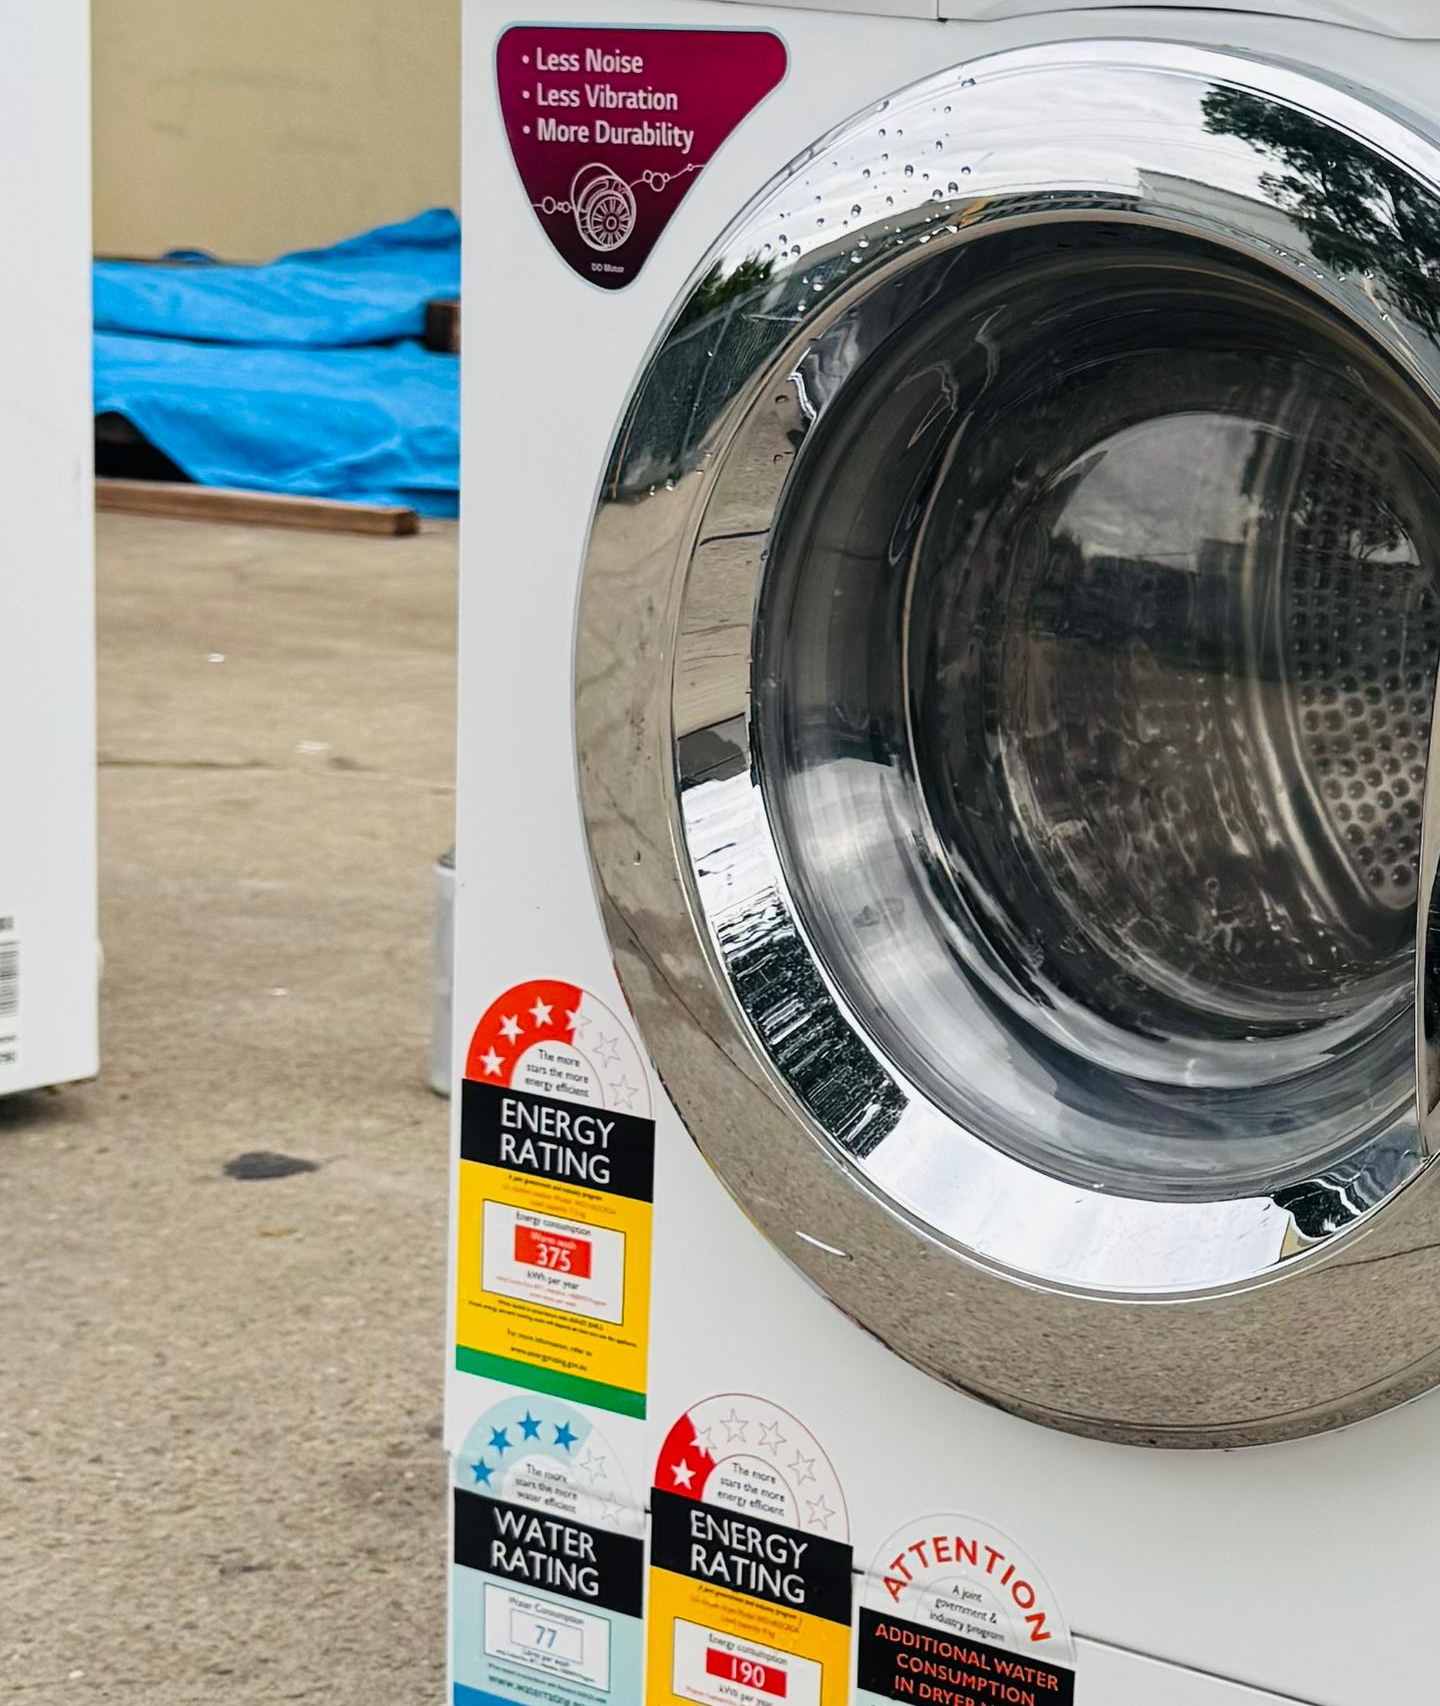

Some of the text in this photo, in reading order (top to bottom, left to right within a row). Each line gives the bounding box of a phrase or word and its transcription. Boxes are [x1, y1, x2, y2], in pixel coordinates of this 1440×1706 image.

[536, 47, 643, 73] Less Noise
[537, 83, 678, 110] Less Vibration
[538, 118, 694, 154] More Durability
[539, 1049, 579, 1066] The more
[525, 1078, 552, 1091] energy
[527, 1065, 588, 1083] stars the more
[501, 1098, 615, 1148] ENERGY
[500, 1133, 610, 1184] RATING
[516, 1211, 540, 1225] Energy
[537, 1243, 571, 1271] 375
[548, 1277, 560, 1285] per
[563, 1281, 579, 1290] year
[527, 1463, 541, 1476] The
[732, 1462, 776, 1483] The more
[516, 1478, 577, 1500] stars the more
[718, 1491, 747, 1507] energy
[721, 1478, 784, 1502] stars the more
[493, 1507, 596, 1562] WATER
[690, 1510, 808, 1569] ENERGY
[491, 1540, 599, 1596] RATING
[691, 1544, 805, 1604] RATING
[883, 1536, 1052, 1642] ATTENTION
[952, 1585, 982, 1602] A joint
[936, 1599, 997, 1623] government &
[536, 1625, 557, 1648] 77
[930, 1610, 1004, 1641] industry program
[709, 1633, 734, 1650] Energy
[875, 1623, 1058, 1691] ADDITIONAL WATER
[732, 1657, 765, 1687] 190
[896, 1654, 1035, 1706] CONSUMPTION
[895, 1676, 914, 1693] IN
[741, 1693, 753, 1701] per
